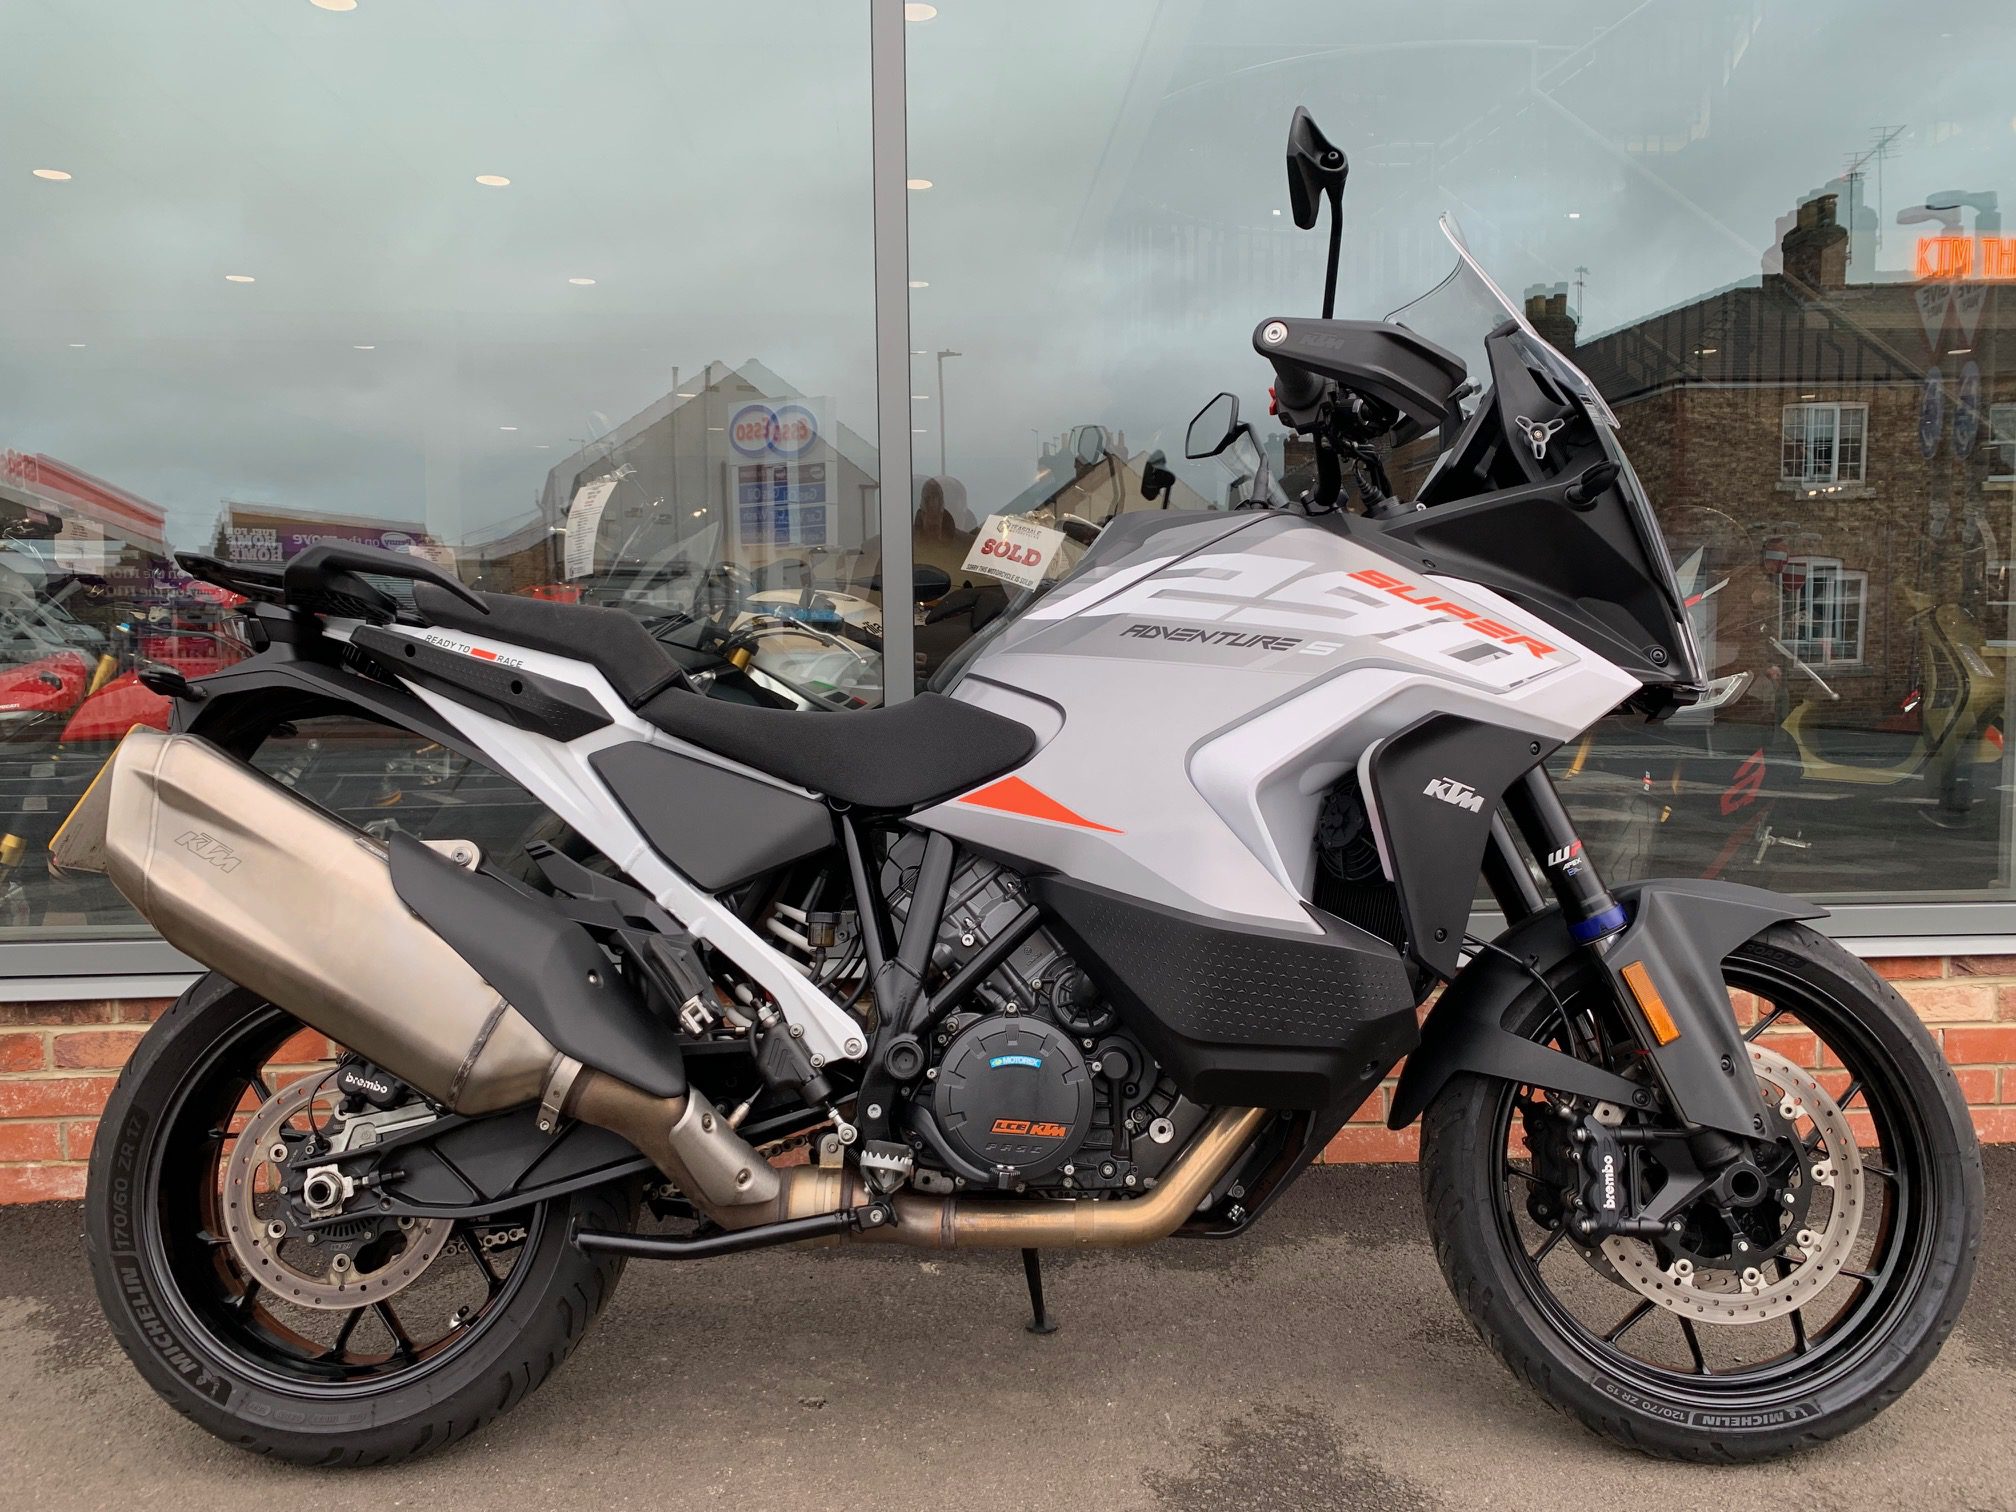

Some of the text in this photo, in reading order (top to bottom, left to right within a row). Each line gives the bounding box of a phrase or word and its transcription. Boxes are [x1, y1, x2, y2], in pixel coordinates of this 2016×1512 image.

[1916, 236, 1973, 277] KTM
[1300, 331, 1345, 349] KTM
[981, 538, 1041, 566] SOLD
[987, 567, 1016, 580] MOTORCYCLE
[1346, 569, 1558, 659] SUPER
[425, 634, 524, 667] READY TO RACE
[1119, 624, 1344, 656] ADVENTURE S
[1423, 776, 1485, 814] KTM
[175, 830, 242, 874] KTM
[1547, 839, 1581, 867] WP
[1002, 1056, 1039, 1066] MOTOREX
[345, 1071, 388, 1094] brembo
[1029, 1122, 1067, 1136] KTM
[113, 1114, 142, 1249] 170/60 ZR 17
[1602, 1154, 1616, 1209] brembo
[120, 1266, 198, 1375] MICHELIN
[1605, 1384, 1686, 1421] 120/70 ZR 19
[1702, 1410, 1785, 1427] MICHELIN
